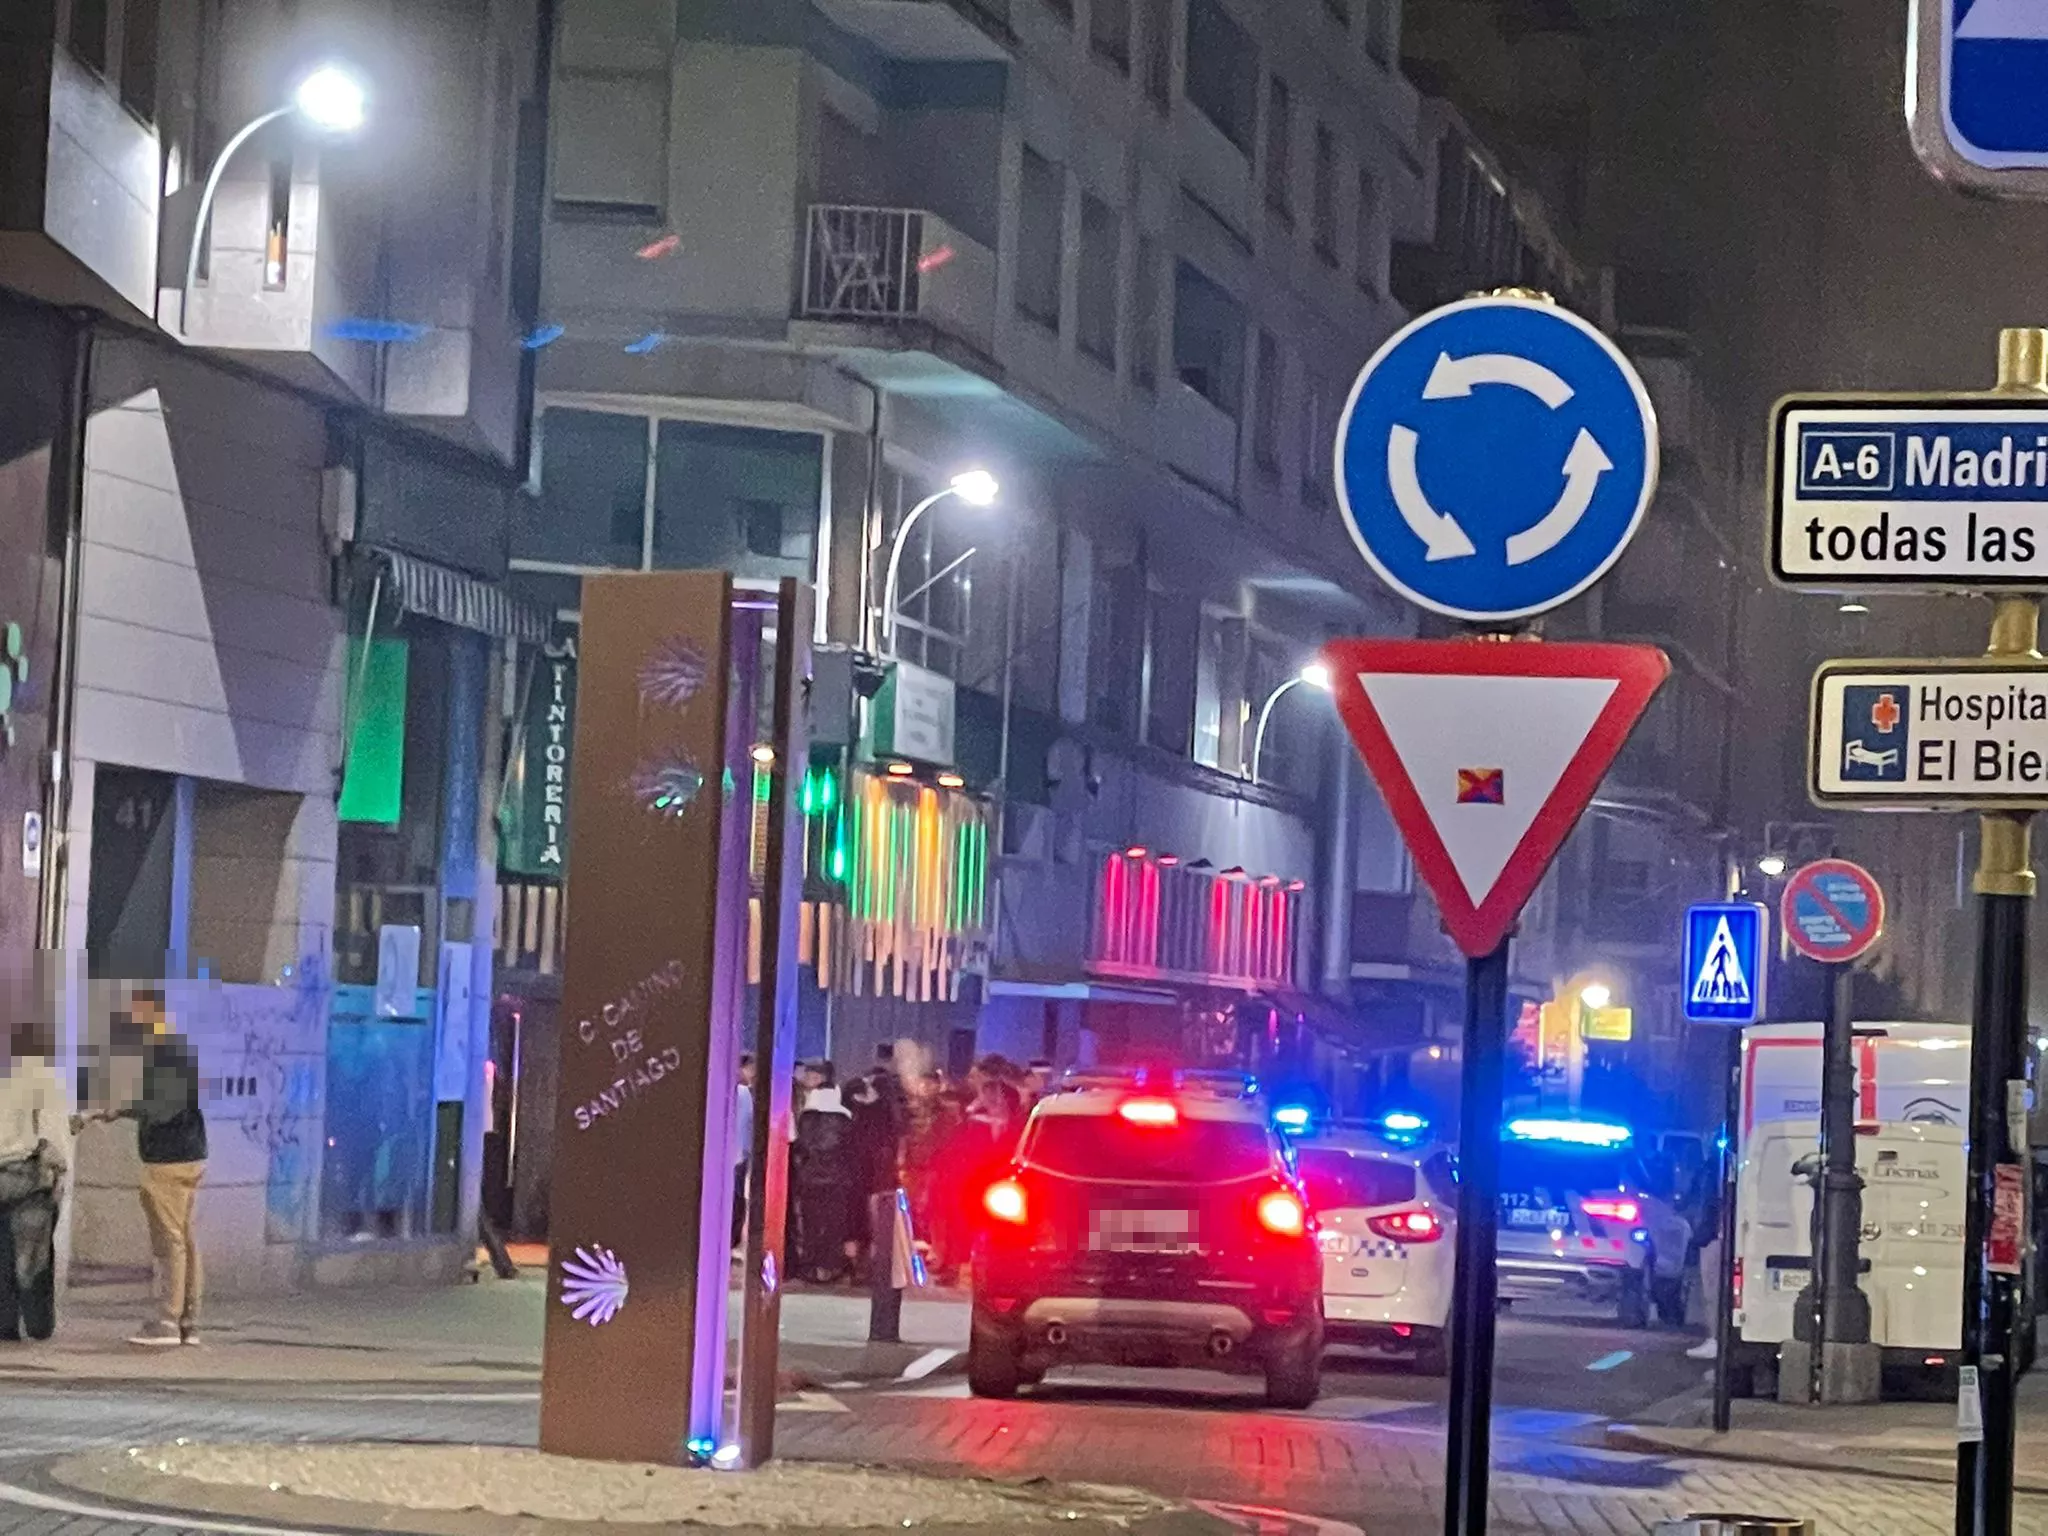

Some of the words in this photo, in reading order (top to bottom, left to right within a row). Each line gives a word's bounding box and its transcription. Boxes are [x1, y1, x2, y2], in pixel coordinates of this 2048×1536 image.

[1811, 443, 1880, 481] A-6
[1805, 512, 1946, 562] todas
[1967, 512, 2036, 563] las
[540, 664, 567, 864] TINTORERIA
[1917, 739, 1956, 781] El
[1974, 739, 2048, 782] Bie
[611, 1029, 643, 1062] DE
[574, 1047, 680, 1130] SANTIAGO
